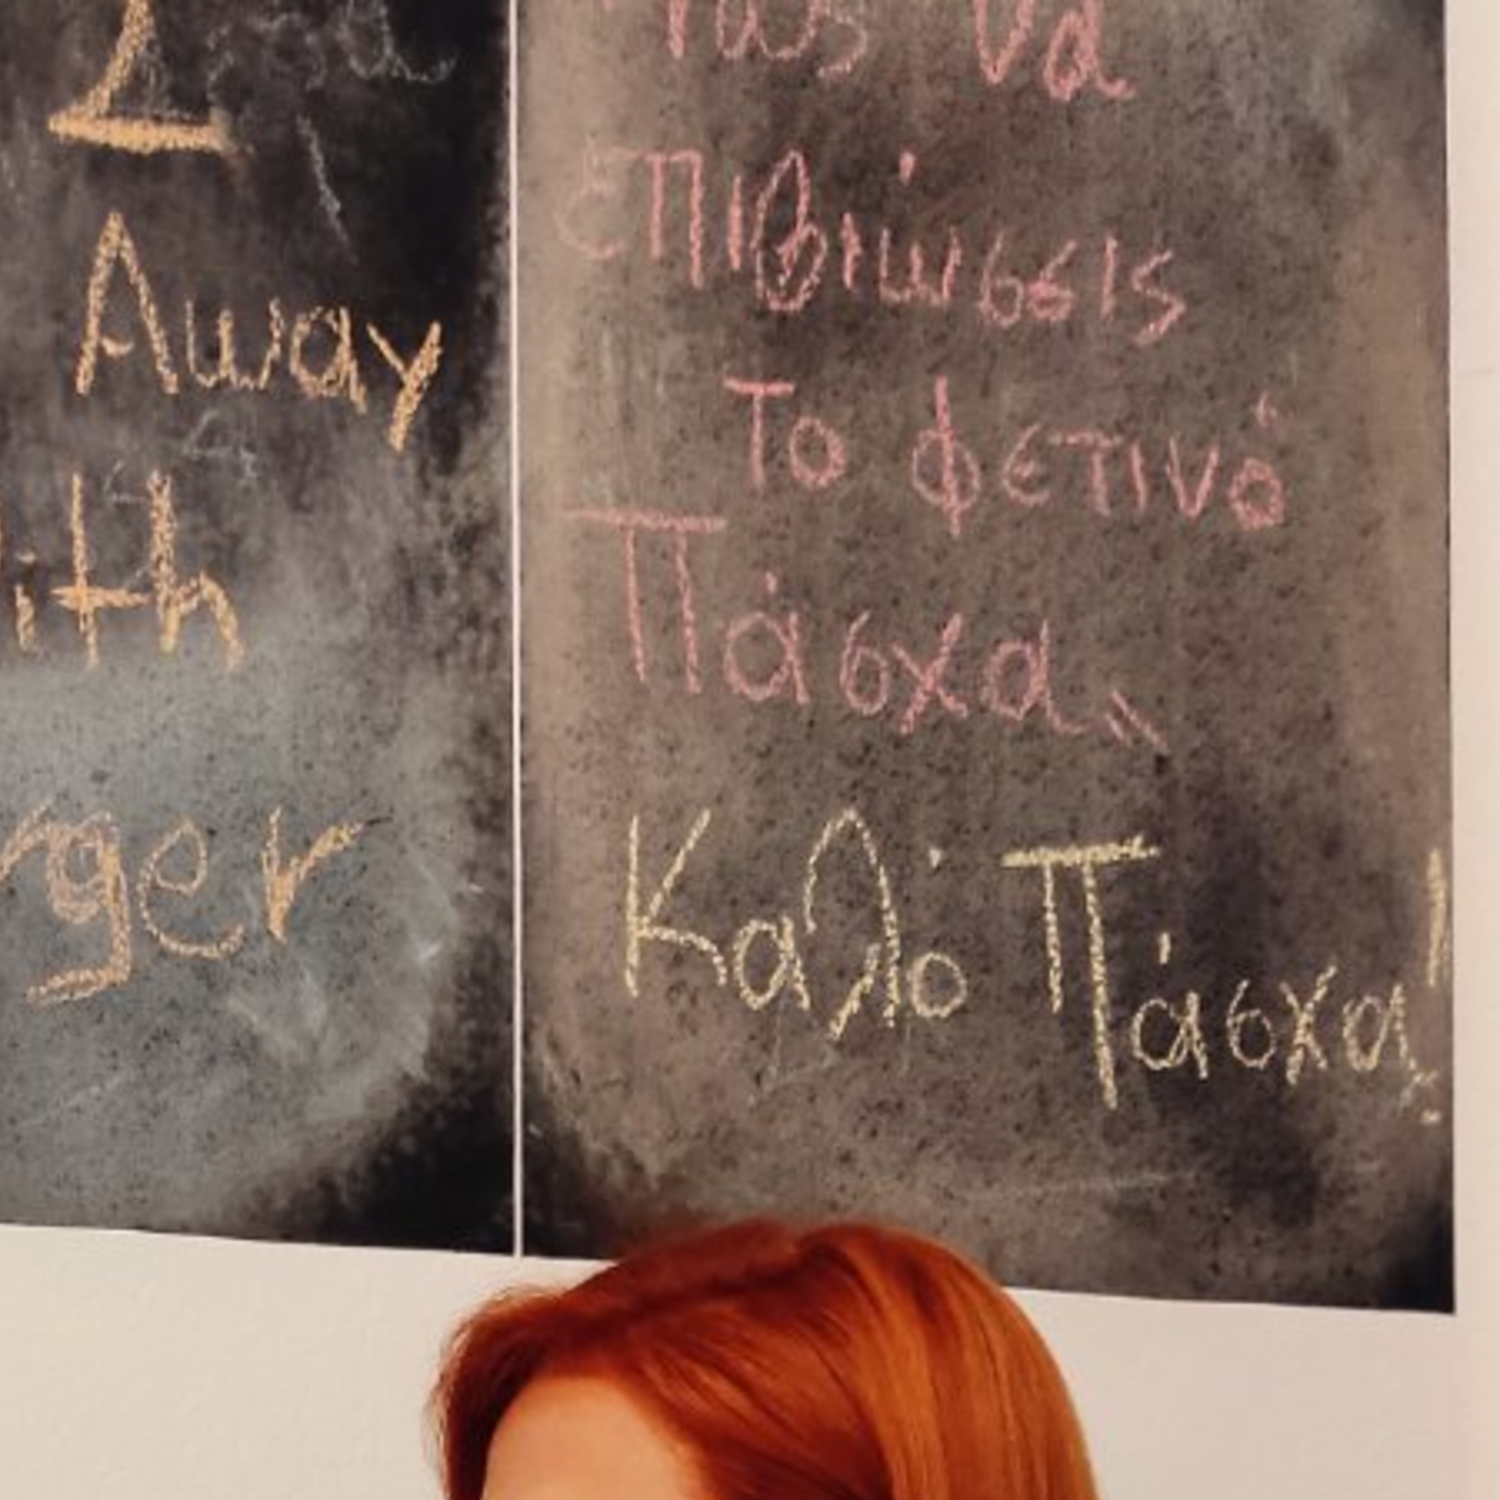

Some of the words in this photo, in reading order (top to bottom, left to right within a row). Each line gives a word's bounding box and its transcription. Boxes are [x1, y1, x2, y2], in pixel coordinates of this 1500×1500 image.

[75, 212, 443, 452] Away
[624, 807, 968, 1042] Καλό
[1001, 835, 1448, 1125] Πάσχα!
